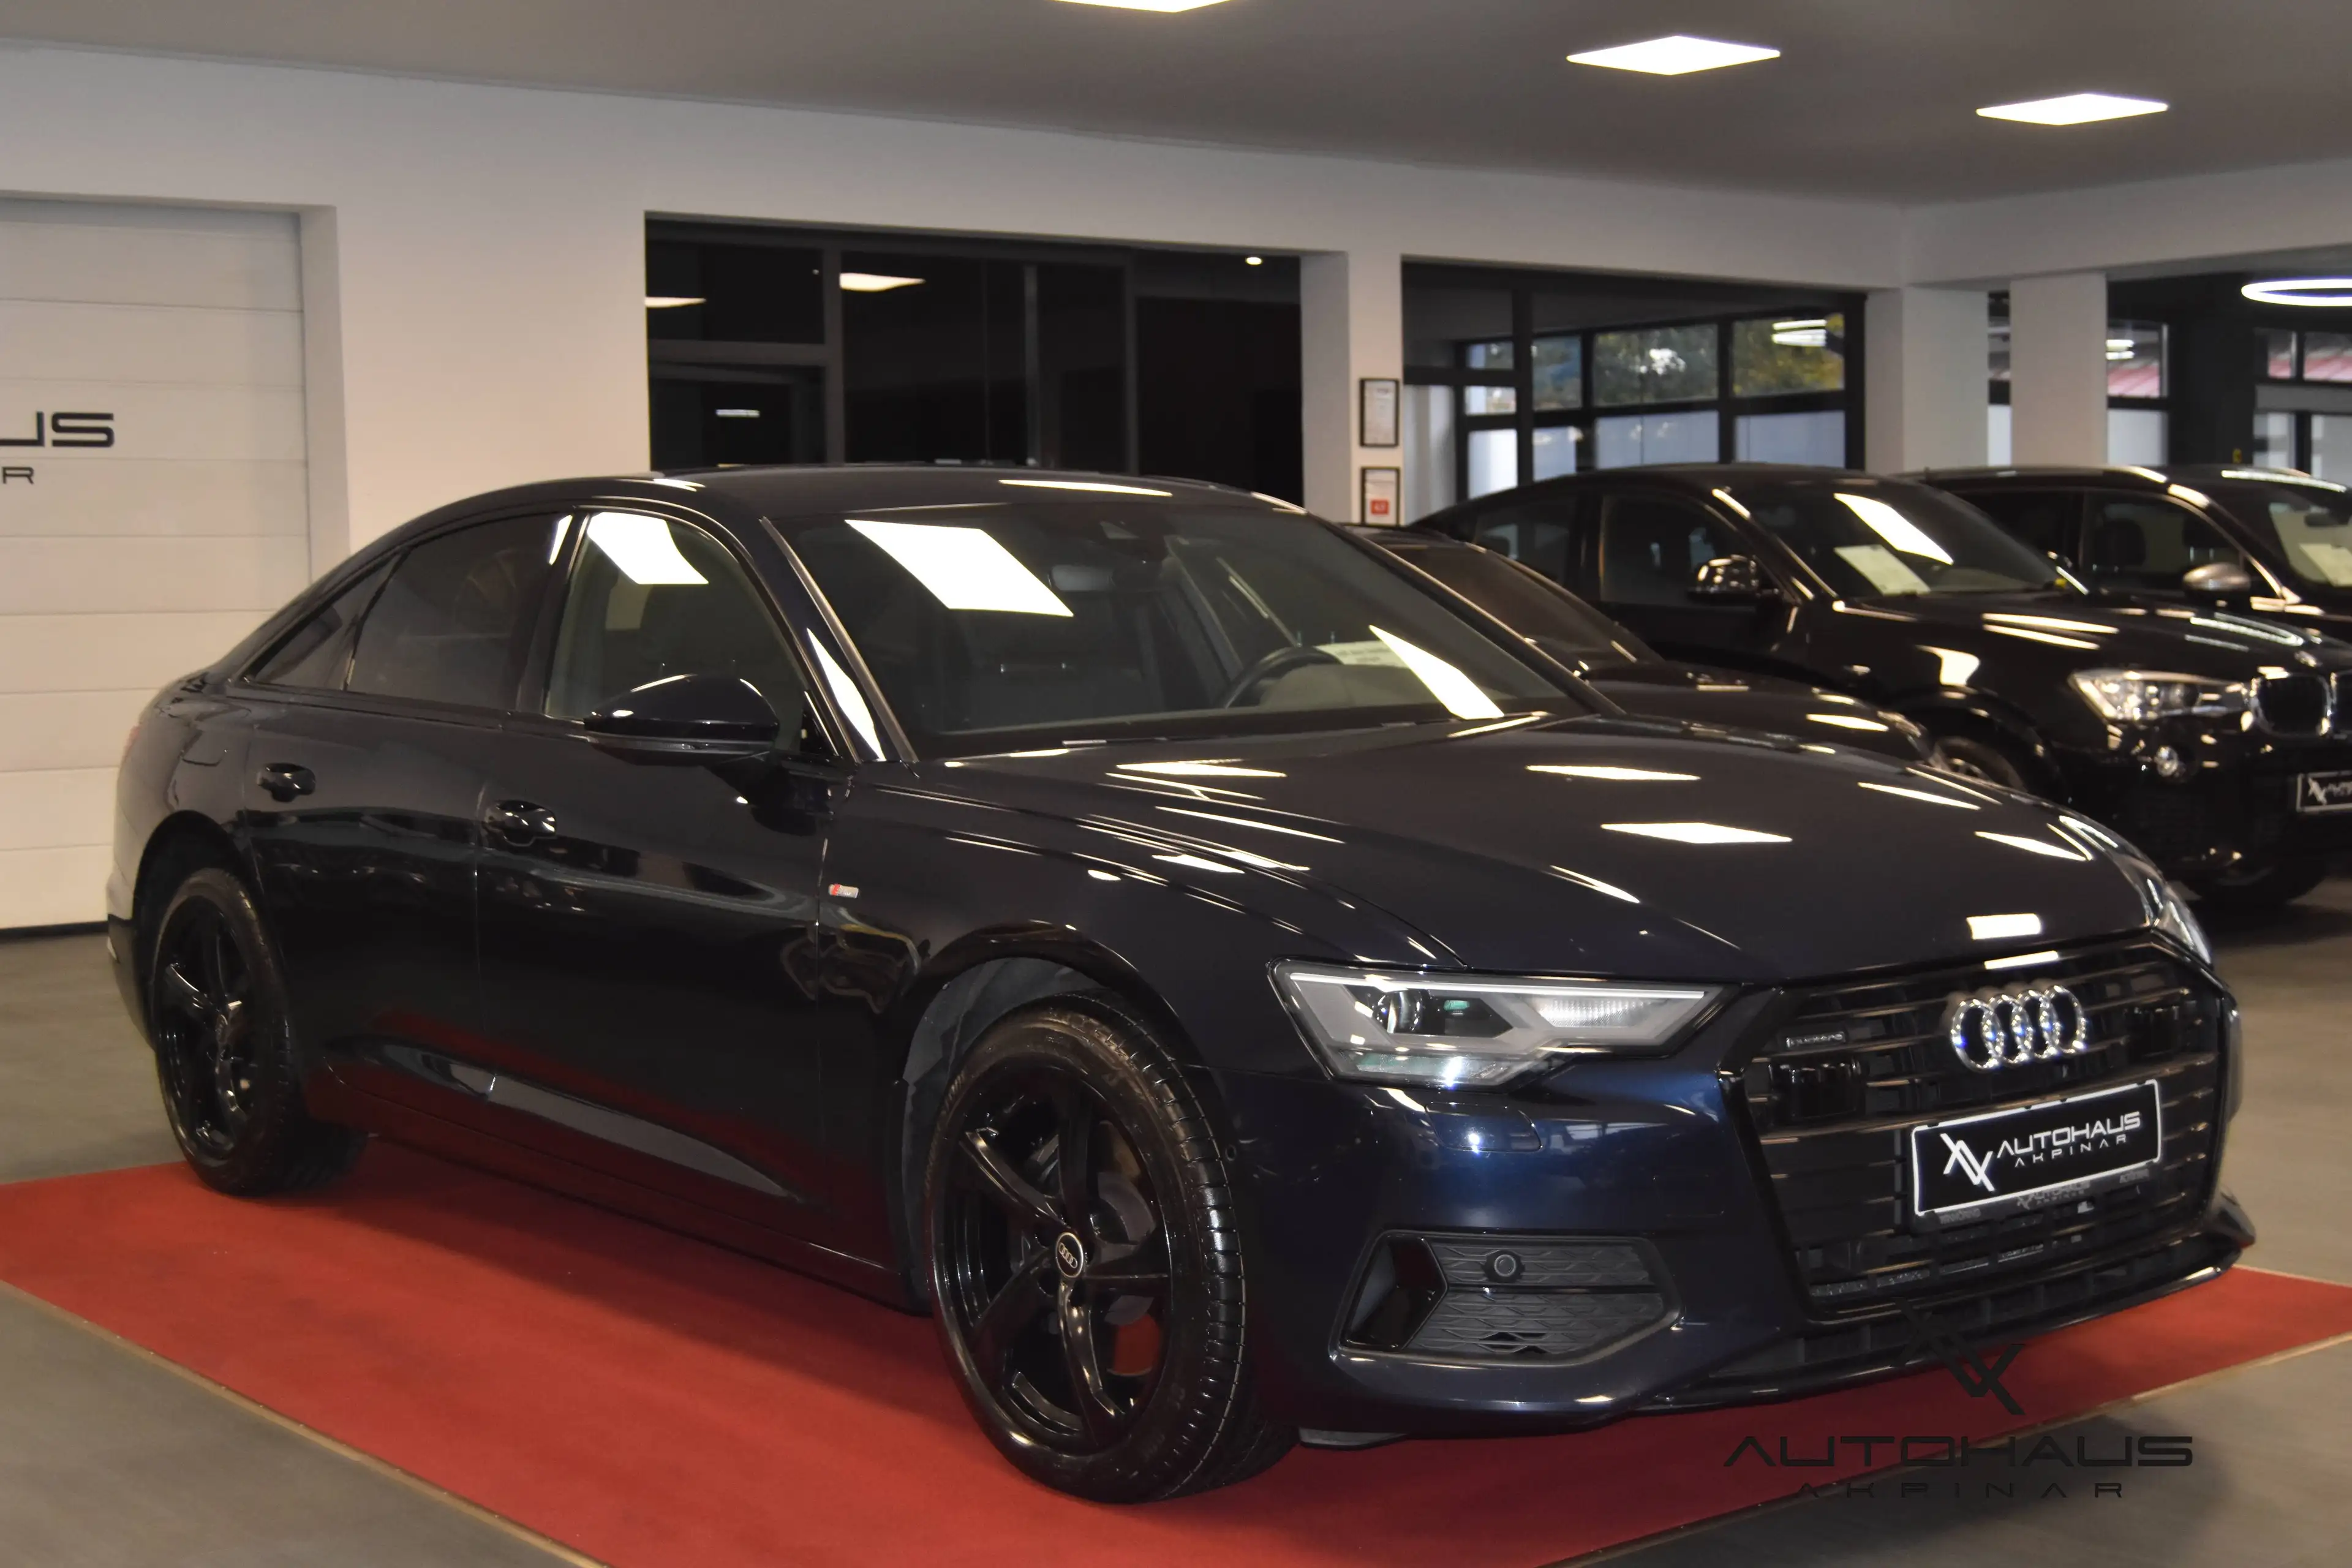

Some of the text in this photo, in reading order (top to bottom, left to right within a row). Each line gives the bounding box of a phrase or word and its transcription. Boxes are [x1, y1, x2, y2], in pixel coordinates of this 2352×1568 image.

[2, 466, 34, 484] R
[1997, 1111, 2141, 1158] AUTOHAUS
[2015, 1134, 2127, 1167] AKPINAR
